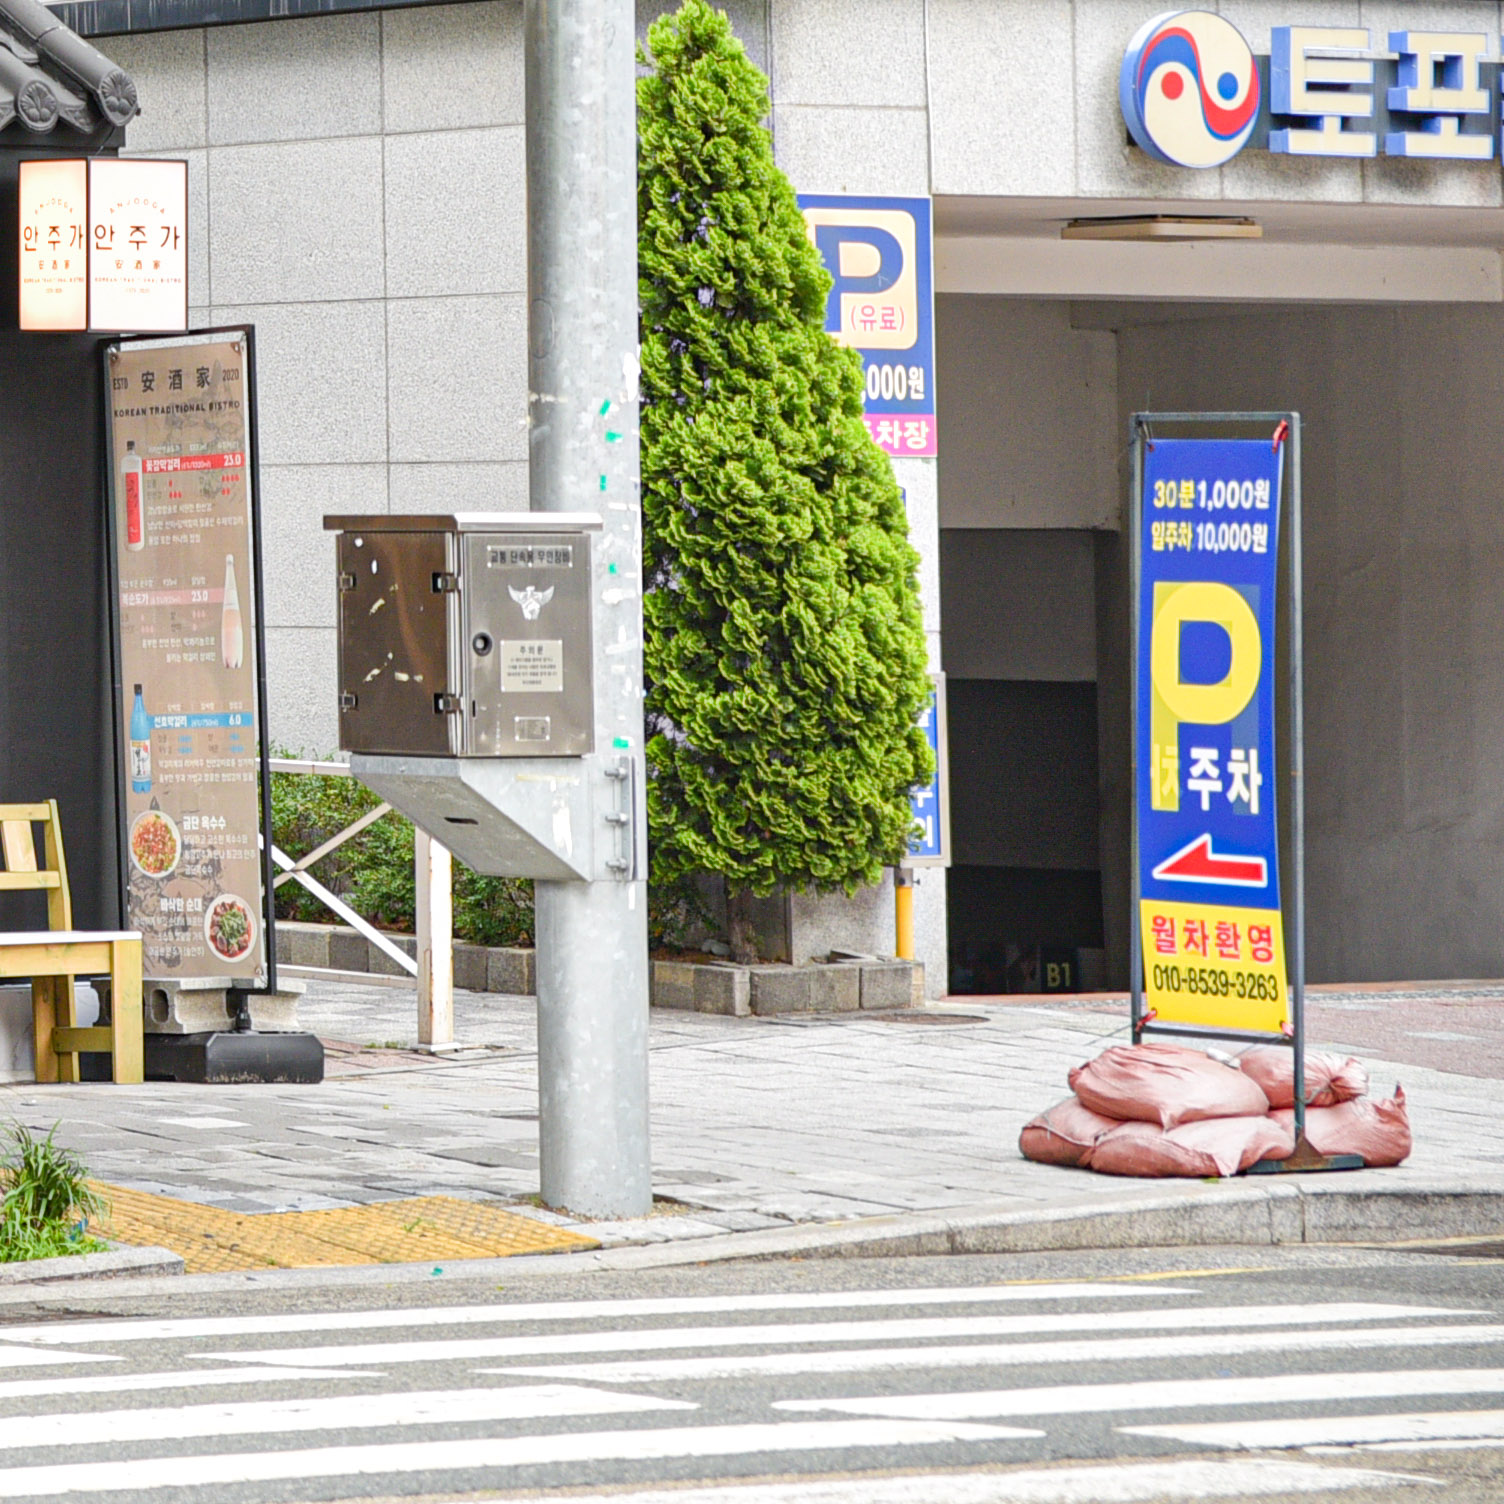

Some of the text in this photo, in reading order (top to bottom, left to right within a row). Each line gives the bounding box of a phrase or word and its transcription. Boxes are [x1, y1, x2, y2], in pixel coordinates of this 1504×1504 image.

[23, 224, 83, 251] 안주가
[94, 224, 180, 250] 안주가
[815, 224, 904, 333] P
[850, 305, 905, 332] (유료)
[113, 377, 129, 390] ESTD
[222, 368, 240, 382] 2020
[114, 407, 147, 417] KOREAN
[150, 403, 206, 415] TRADITIONAL
[864, 419, 930, 450] 차장
[1153, 478, 1270, 512] 30분 1,000원
[1196, 521, 1268, 554] 10,000원
[1151, 581, 1263, 812] P
[1187, 747, 1262, 815] 주차
[1047, 962, 1071, 987] B1
[1153, 963, 1279, 1002] 010-8539-3263
